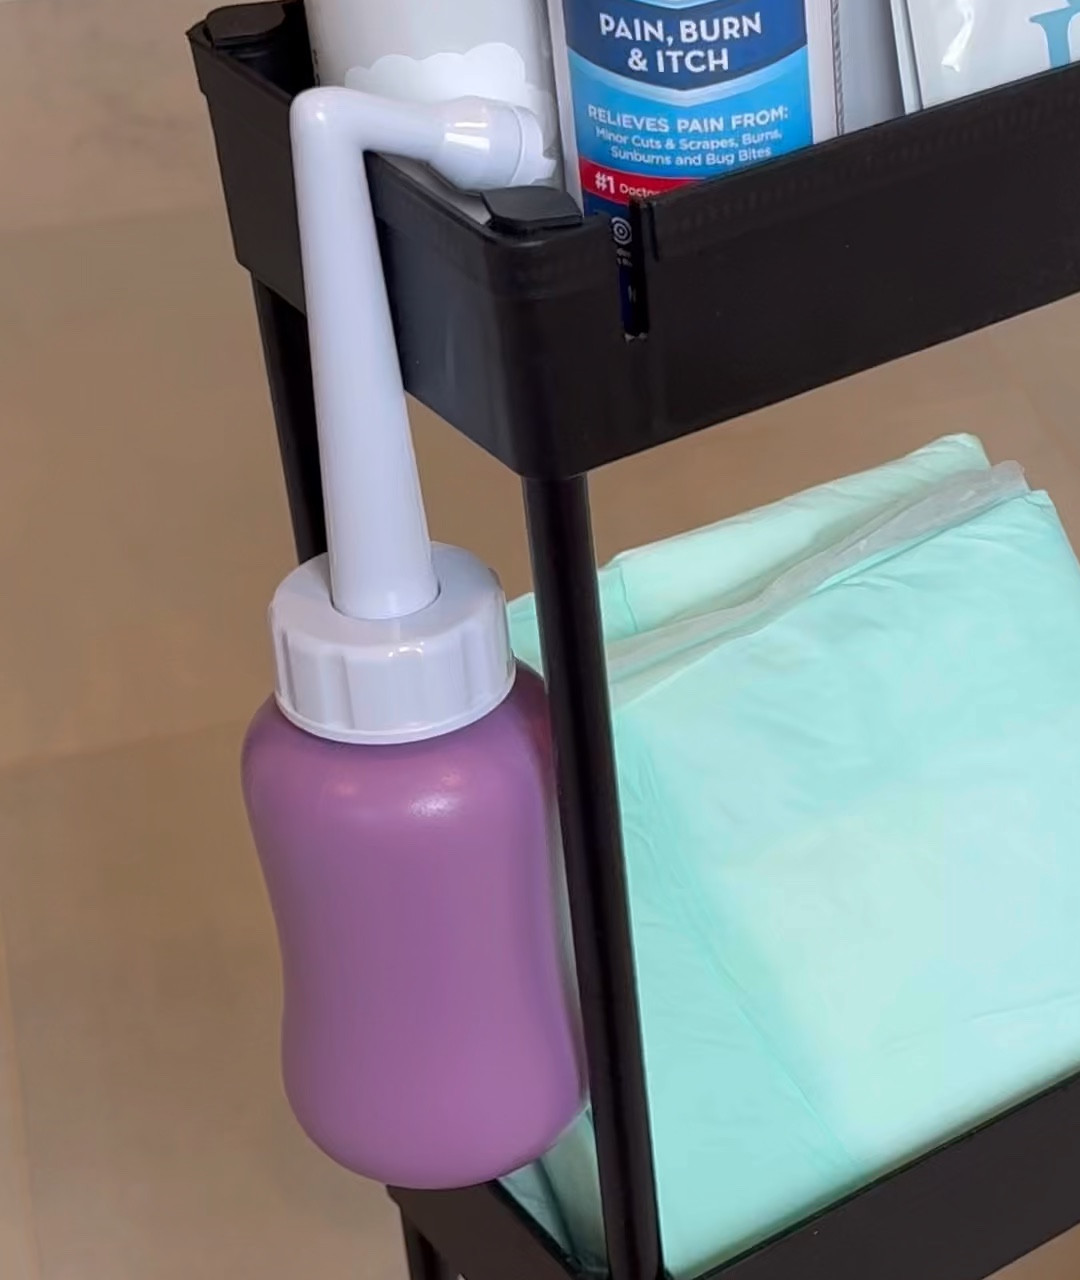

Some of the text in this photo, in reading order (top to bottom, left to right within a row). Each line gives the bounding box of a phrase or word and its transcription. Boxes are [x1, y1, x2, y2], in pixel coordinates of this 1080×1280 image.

[599, 11, 762, 44] PAIN, BURN
[627, 48, 730, 73] & ITCH
[588, 103, 789, 133] RELIEVES PAIN FROM:
[595, 125, 783, 152] Minor Cuts & Scrapes, Burns,
[611, 145, 772, 167] Sunburns and Bug Bites
[595, 171, 616, 195] #1
